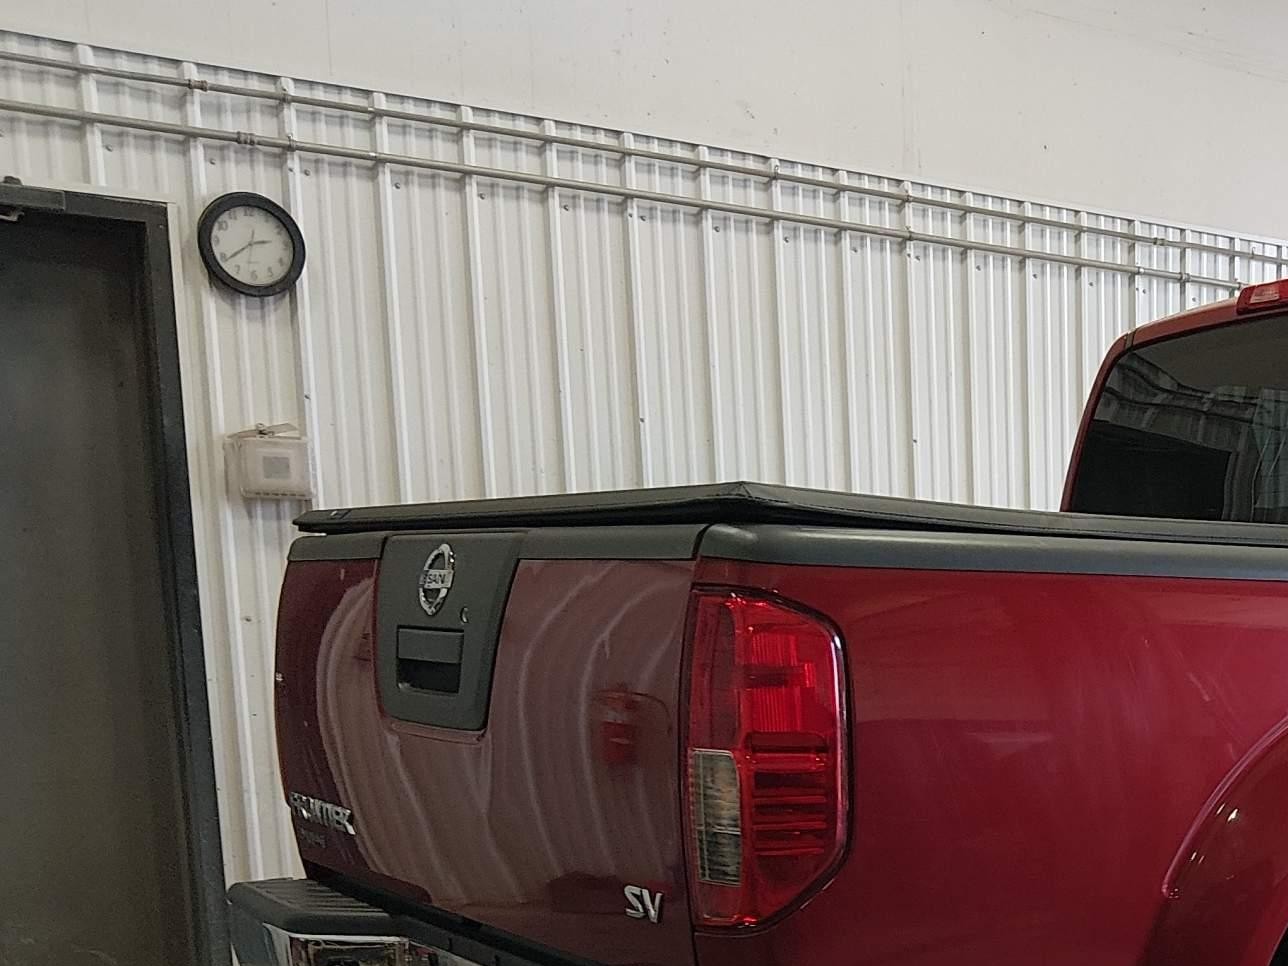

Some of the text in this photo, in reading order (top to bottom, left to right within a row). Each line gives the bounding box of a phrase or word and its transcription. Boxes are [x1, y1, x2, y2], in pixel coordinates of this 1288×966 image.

[243, 208, 255, 217] 12
[217, 220, 229, 231] 10
[624, 885, 663, 923] SV
